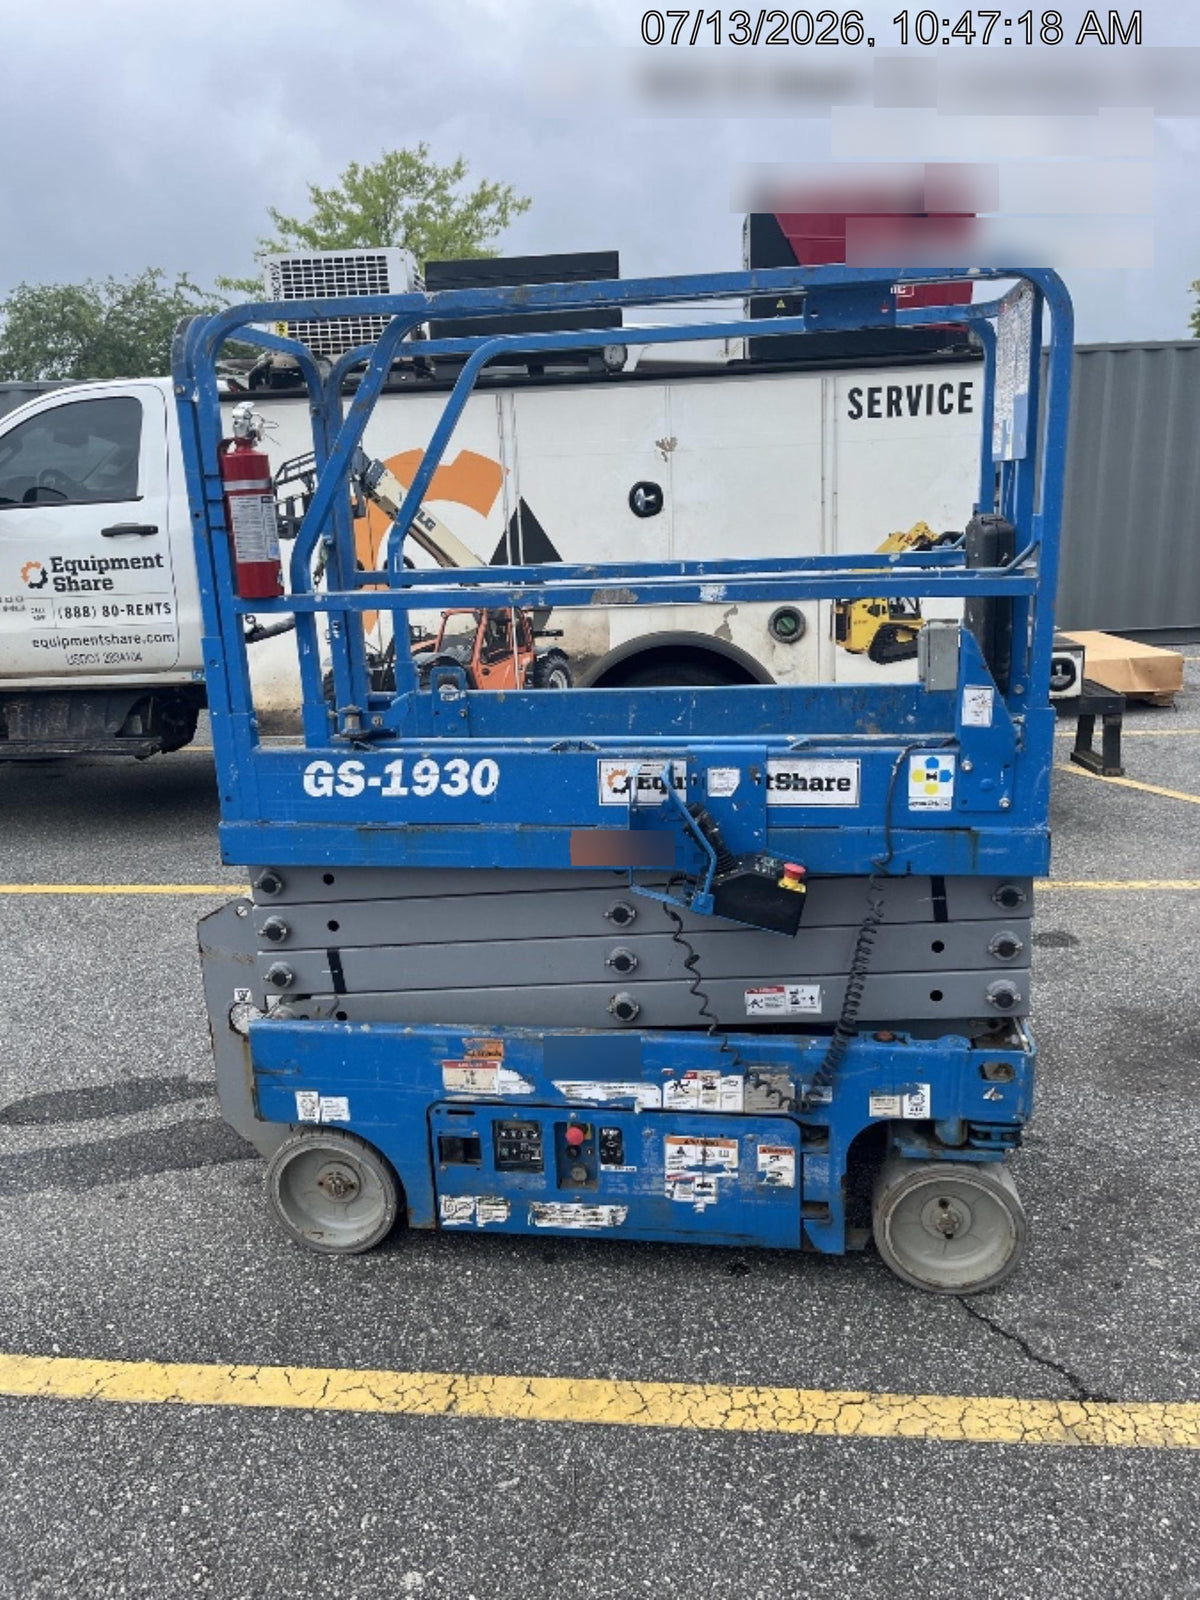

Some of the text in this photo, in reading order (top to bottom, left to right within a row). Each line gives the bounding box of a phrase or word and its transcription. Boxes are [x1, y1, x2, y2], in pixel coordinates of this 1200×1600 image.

[847, 382, 974, 420] SERVICE
[50, 553, 164, 576] Equipment
[53, 575, 114, 593] Share
[58, 602, 172, 619] (888) 80-RENTS
[32, 633, 175, 649] equipmentshare.com
[303, 758, 500, 797] GS-1930
